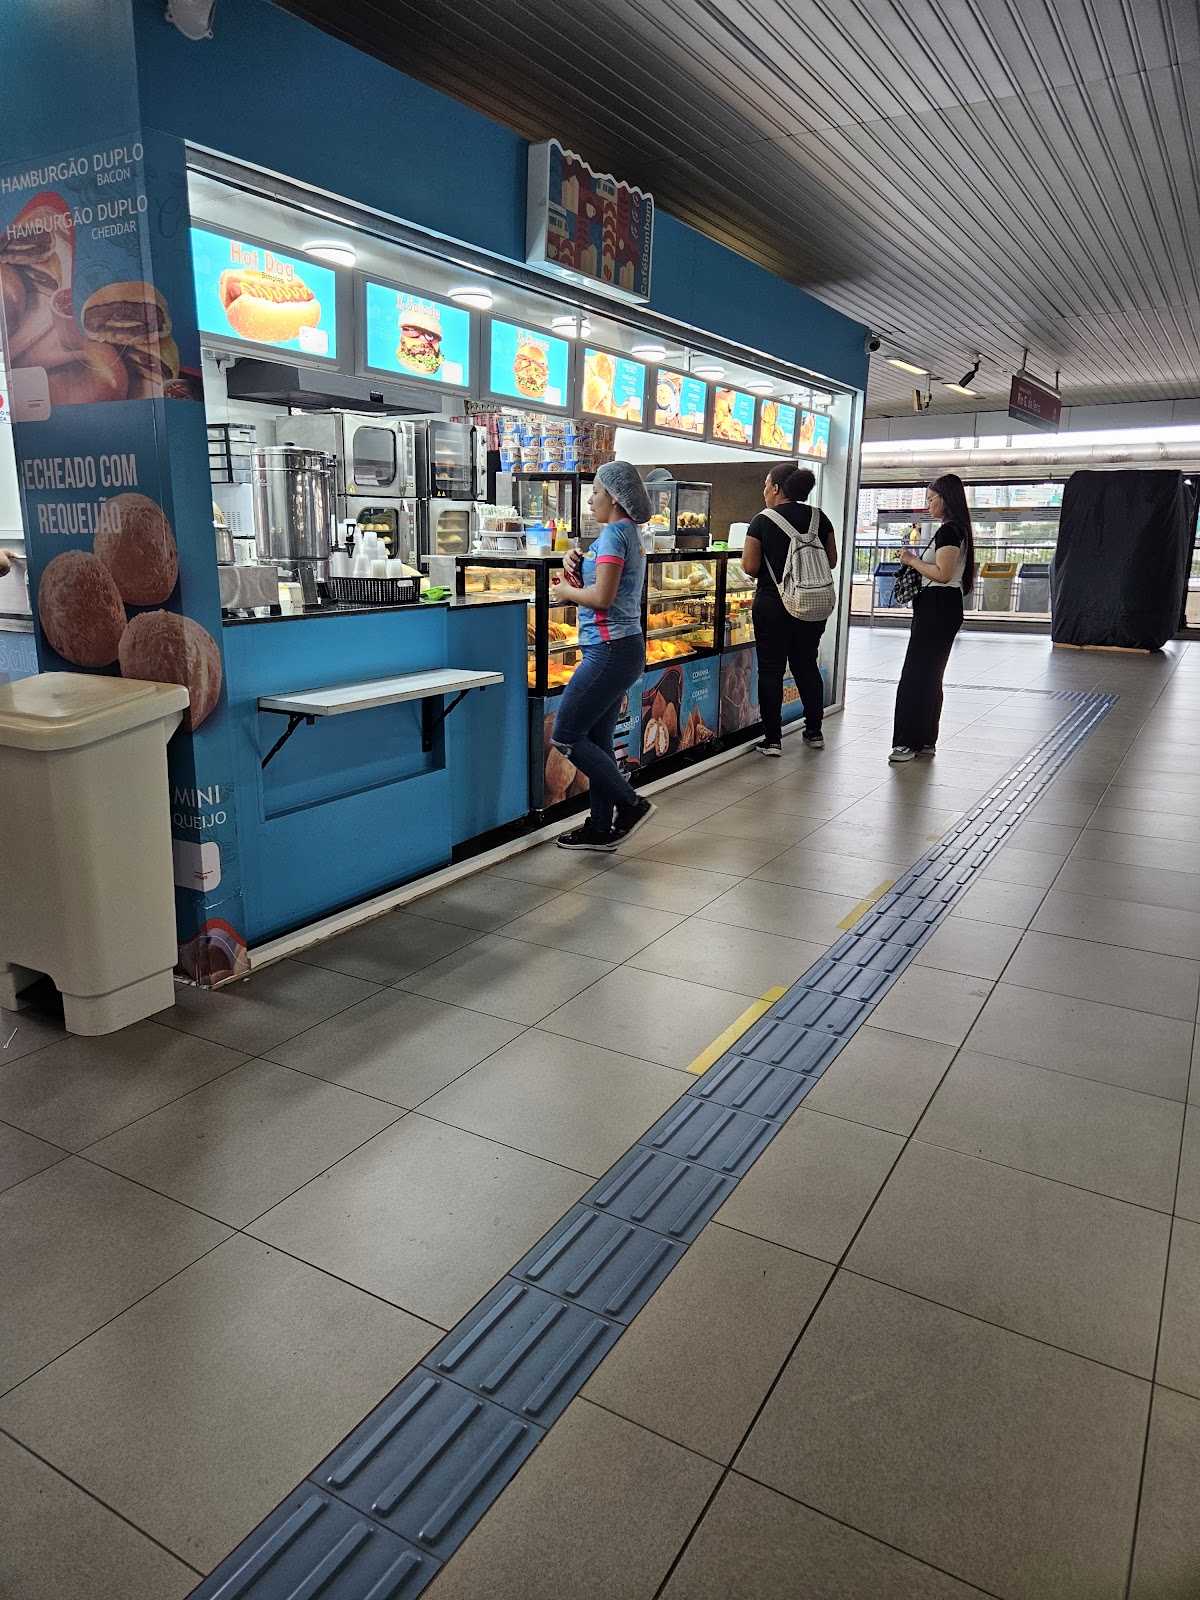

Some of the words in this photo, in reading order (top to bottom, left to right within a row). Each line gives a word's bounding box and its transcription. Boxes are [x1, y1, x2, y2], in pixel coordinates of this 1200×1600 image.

[1, 157, 89, 194] HAMBURGÃO
[93, 142, 144, 172] DUPLO
[96, 167, 131, 186] BACON
[6, 207, 93, 241] HAMBURGÃO
[97, 195, 148, 221] DUPLO
[91, 220, 137, 240] CHEDDAR
[230, 240, 259, 268] Hot
[264, 250, 294, 282] Dog
[640, 201, 652, 295] CaféBombom
[261, 272, 284, 284] Simples
[21, 456, 97, 490] ECHEADO
[99, 454, 138, 488] COM
[37, 497, 122, 536] REQUEIJÃO
[174, 784, 221, 809] MINI
[173, 811, 227, 830] QUEIJO
